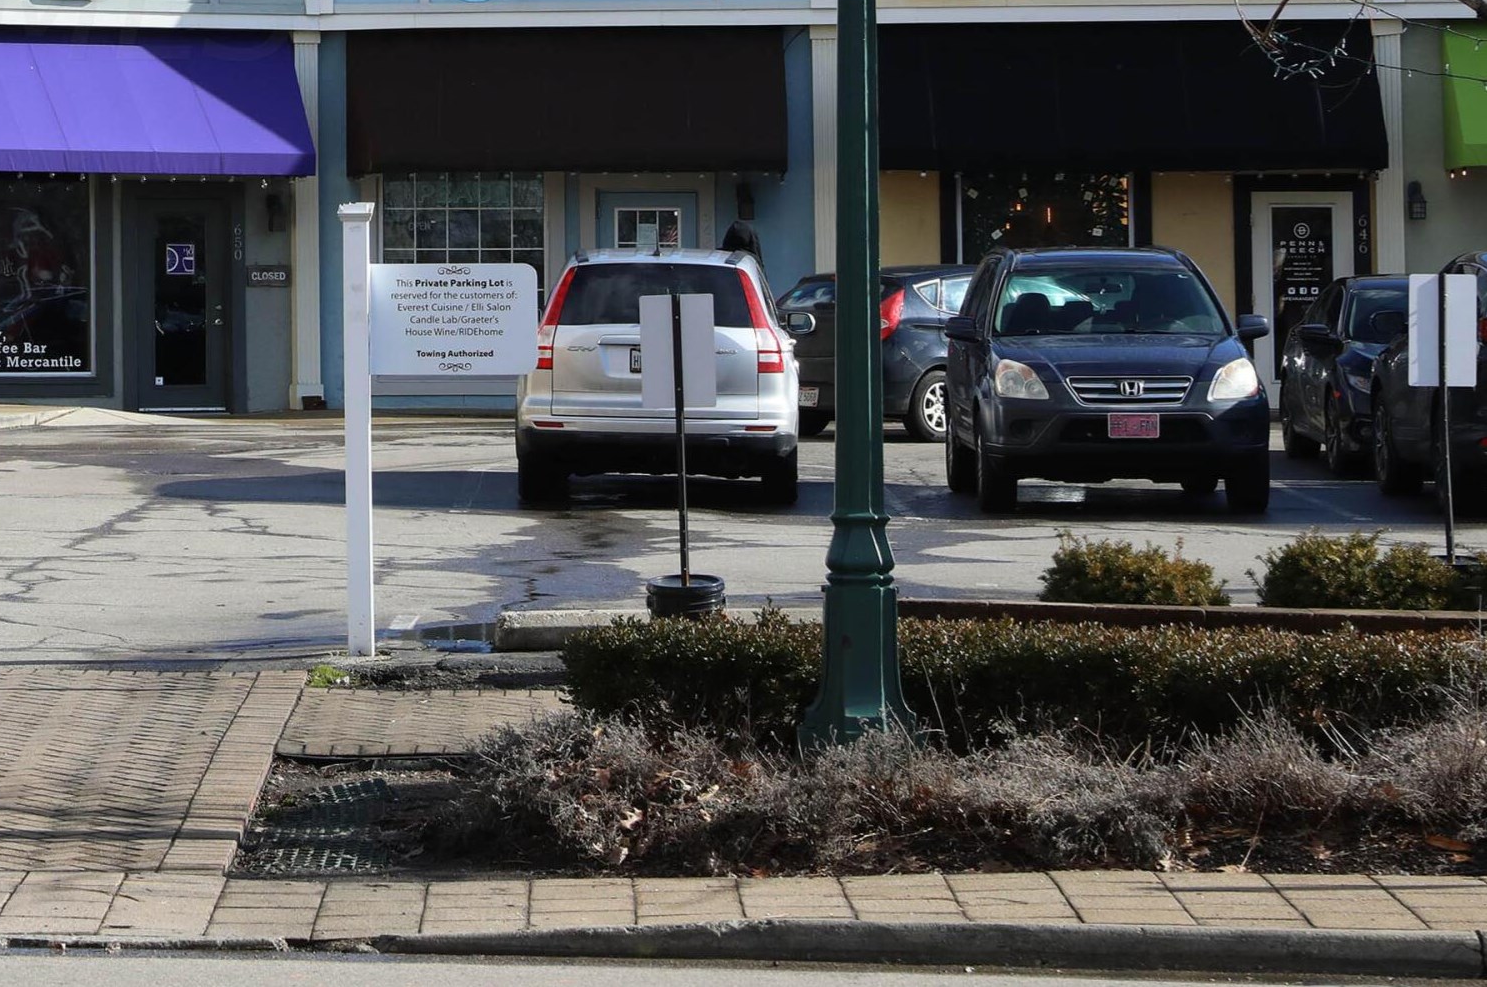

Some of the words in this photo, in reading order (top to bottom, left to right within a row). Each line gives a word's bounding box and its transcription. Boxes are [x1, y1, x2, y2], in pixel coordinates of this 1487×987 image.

[234, 223, 242, 260] 650
[251, 272, 286, 281] CLOSED
[396, 279, 413, 287] This
[415, 279, 448, 287] Private
[451, 279, 487, 289] Parking
[489, 279, 504, 287] Lot
[506, 279, 512, 287] is
[405, 328, 433, 336] House
[23, 342, 47, 354] Bar
[417, 350, 446, 358] Towing
[6, 355, 81, 368] Mercantile
